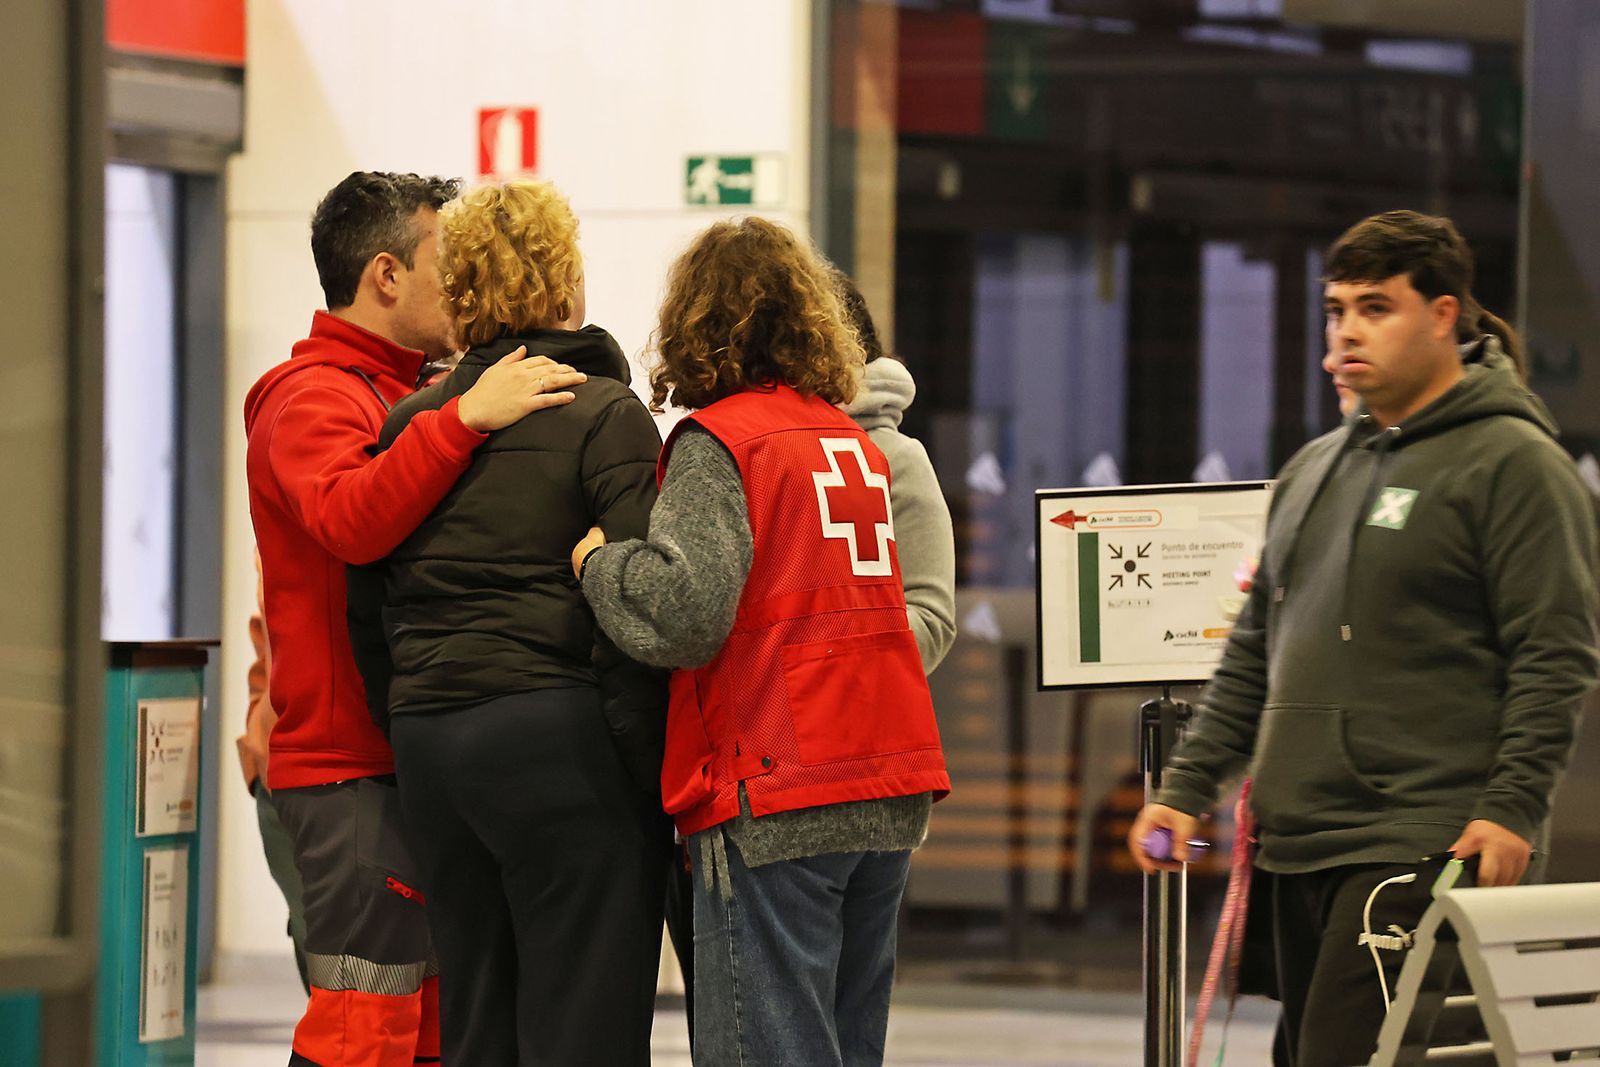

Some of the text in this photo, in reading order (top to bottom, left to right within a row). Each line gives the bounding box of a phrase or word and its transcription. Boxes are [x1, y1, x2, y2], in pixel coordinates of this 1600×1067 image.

[1161, 541, 1244, 552] Punto de encuentro
[1162, 570, 1211, 579] MEETING POINT
